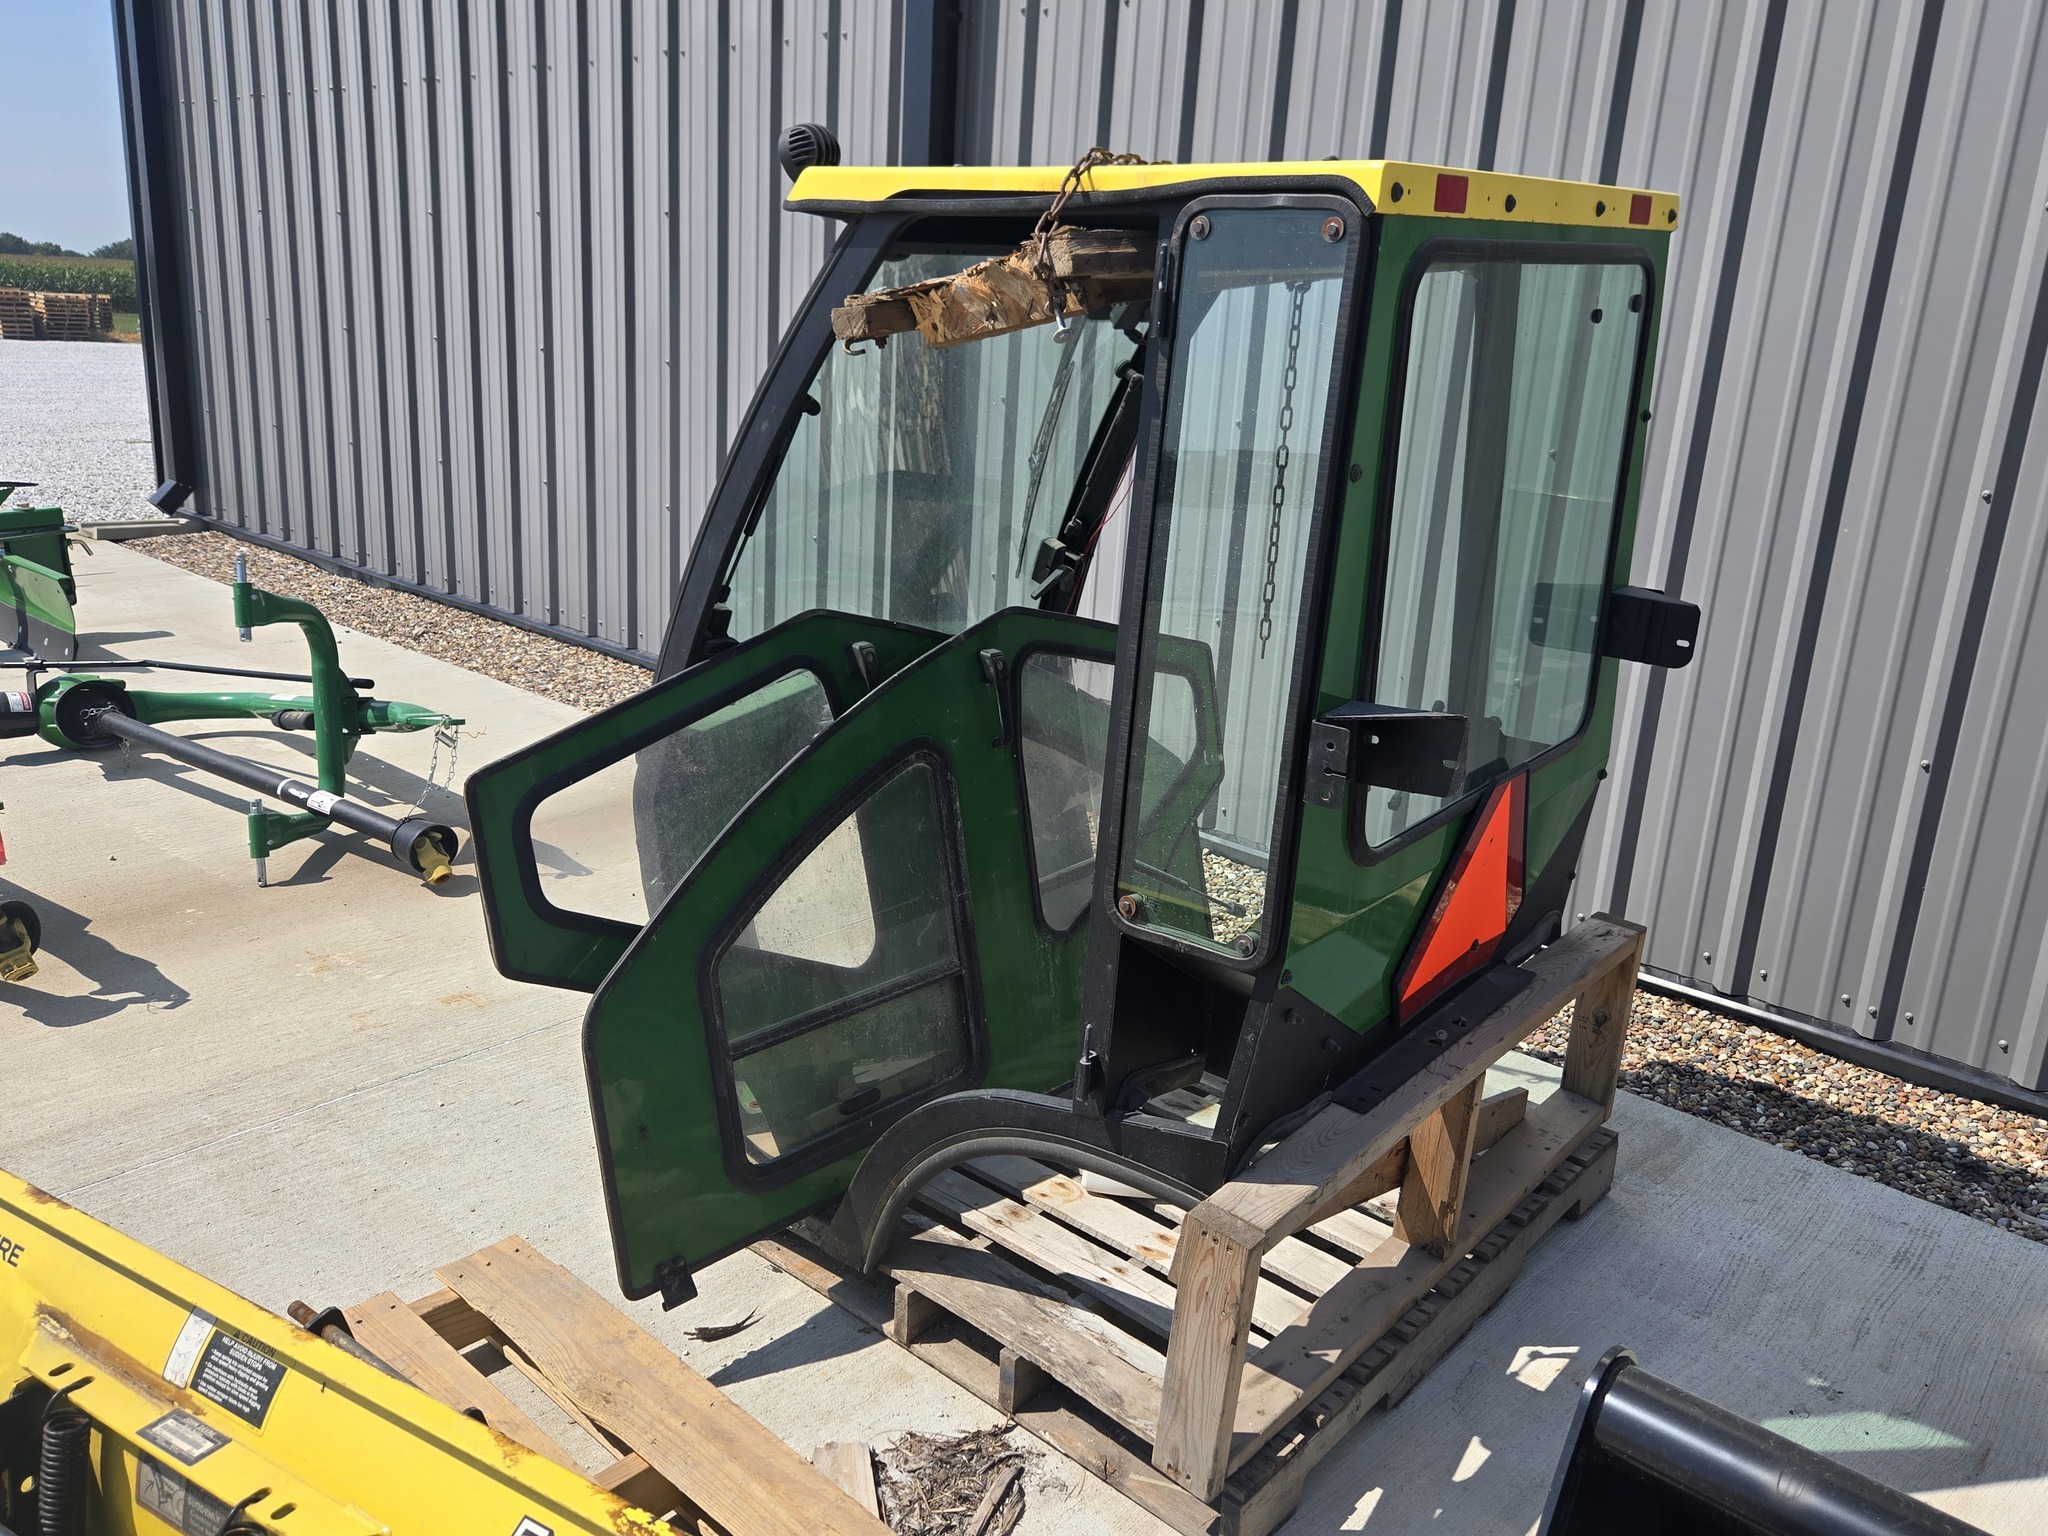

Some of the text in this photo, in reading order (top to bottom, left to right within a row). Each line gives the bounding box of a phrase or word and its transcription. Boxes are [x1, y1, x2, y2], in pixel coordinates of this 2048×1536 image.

[222, 1336, 277, 1370] HELP AVOID INJURY FROM
[242, 1334, 276, 1358] CAUTION
[230, 1348, 262, 1371] SUDDEN STOPS
[184, 1417, 200, 1427] JOHN
[198, 1425, 217, 1437] DEERE
[188, 1496, 220, 1524] SUDDENLY
